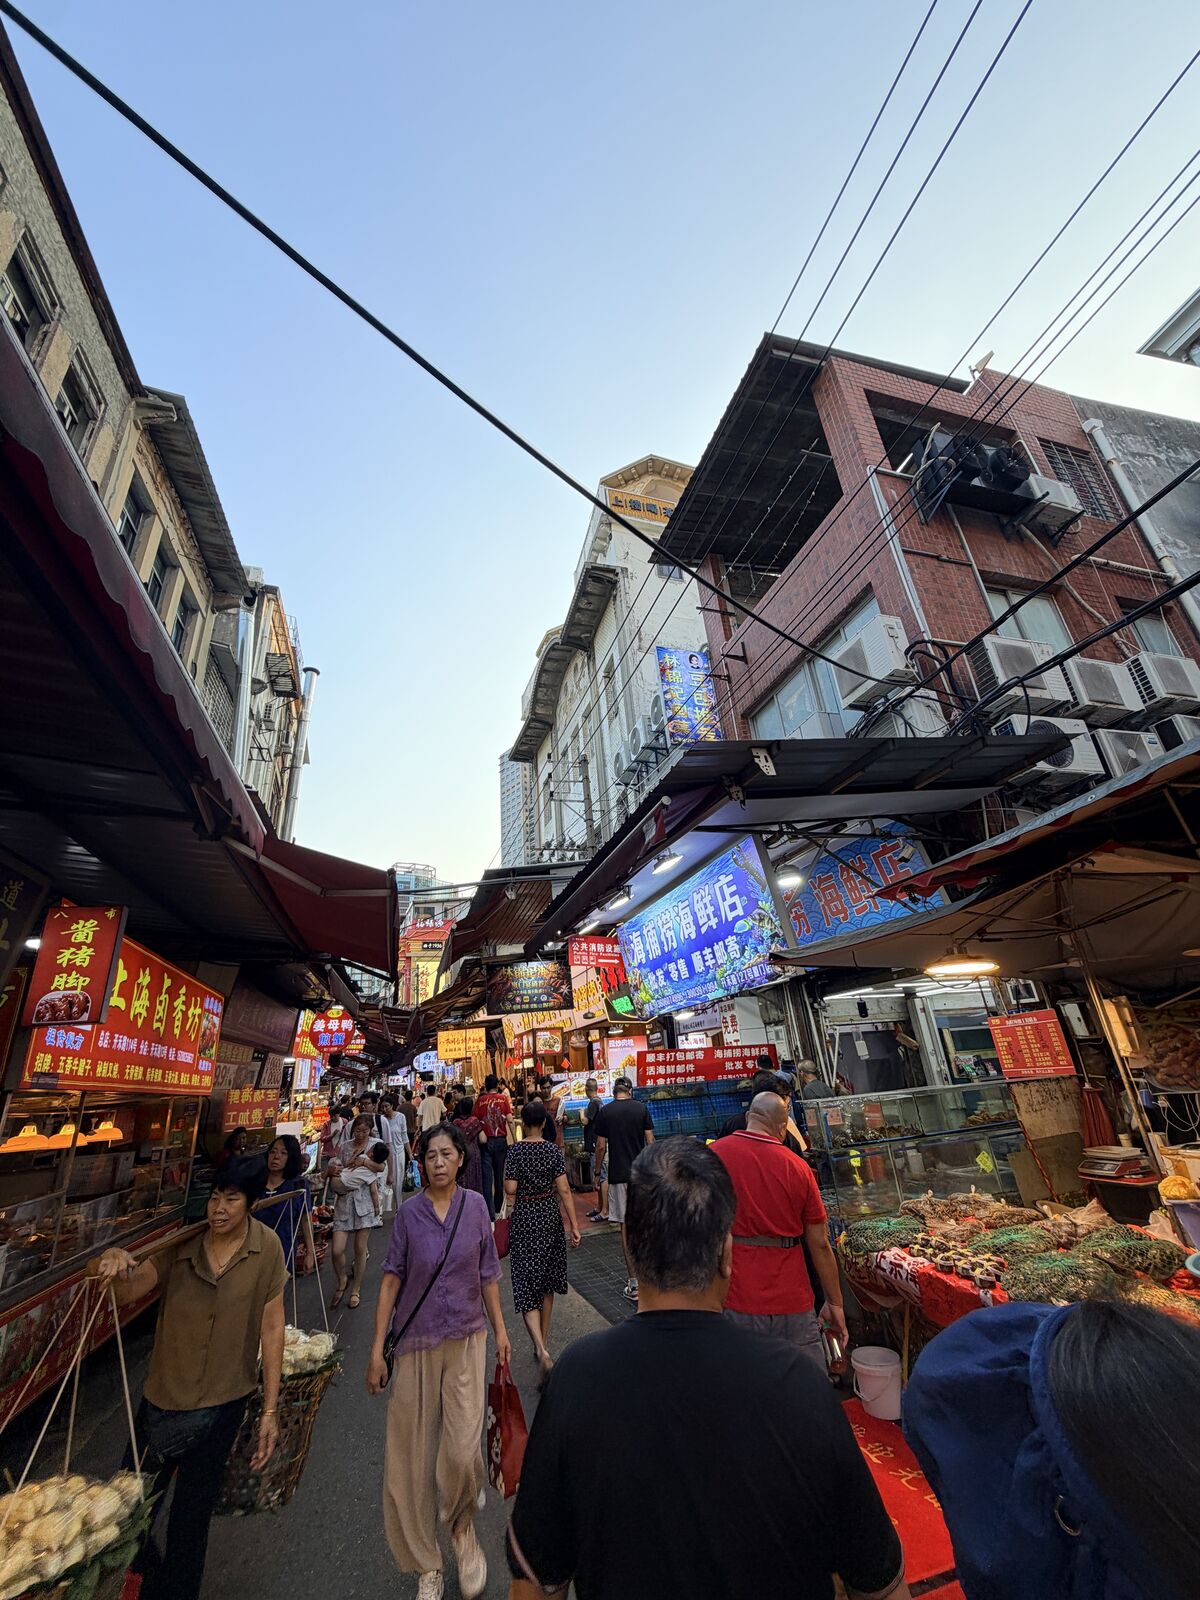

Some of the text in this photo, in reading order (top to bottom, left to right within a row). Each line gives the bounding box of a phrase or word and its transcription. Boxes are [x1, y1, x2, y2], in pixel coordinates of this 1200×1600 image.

[629, 873, 744, 965] 海捕捞海鲜店
[51, 919, 100, 993] 酱猪脚
[572, 942, 621, 953] 公共消防设施
[647, 935, 741, 990] 批发 零售 顺丰邮寄
[109, 958, 202, 1042] 上海卤香坊
[313, 1019, 353, 1032] 姜母鸭
[722, 1014, 738, 1034] 免费
[318, 1033, 345, 1046] 煎蟹
[646, 1047, 769, 1063] 顺丰打包邮寄 海捕捞海鲜店
[646, 1063, 695, 1076] 活海鲜邮件
[725, 1061, 743, 1071] 批发
